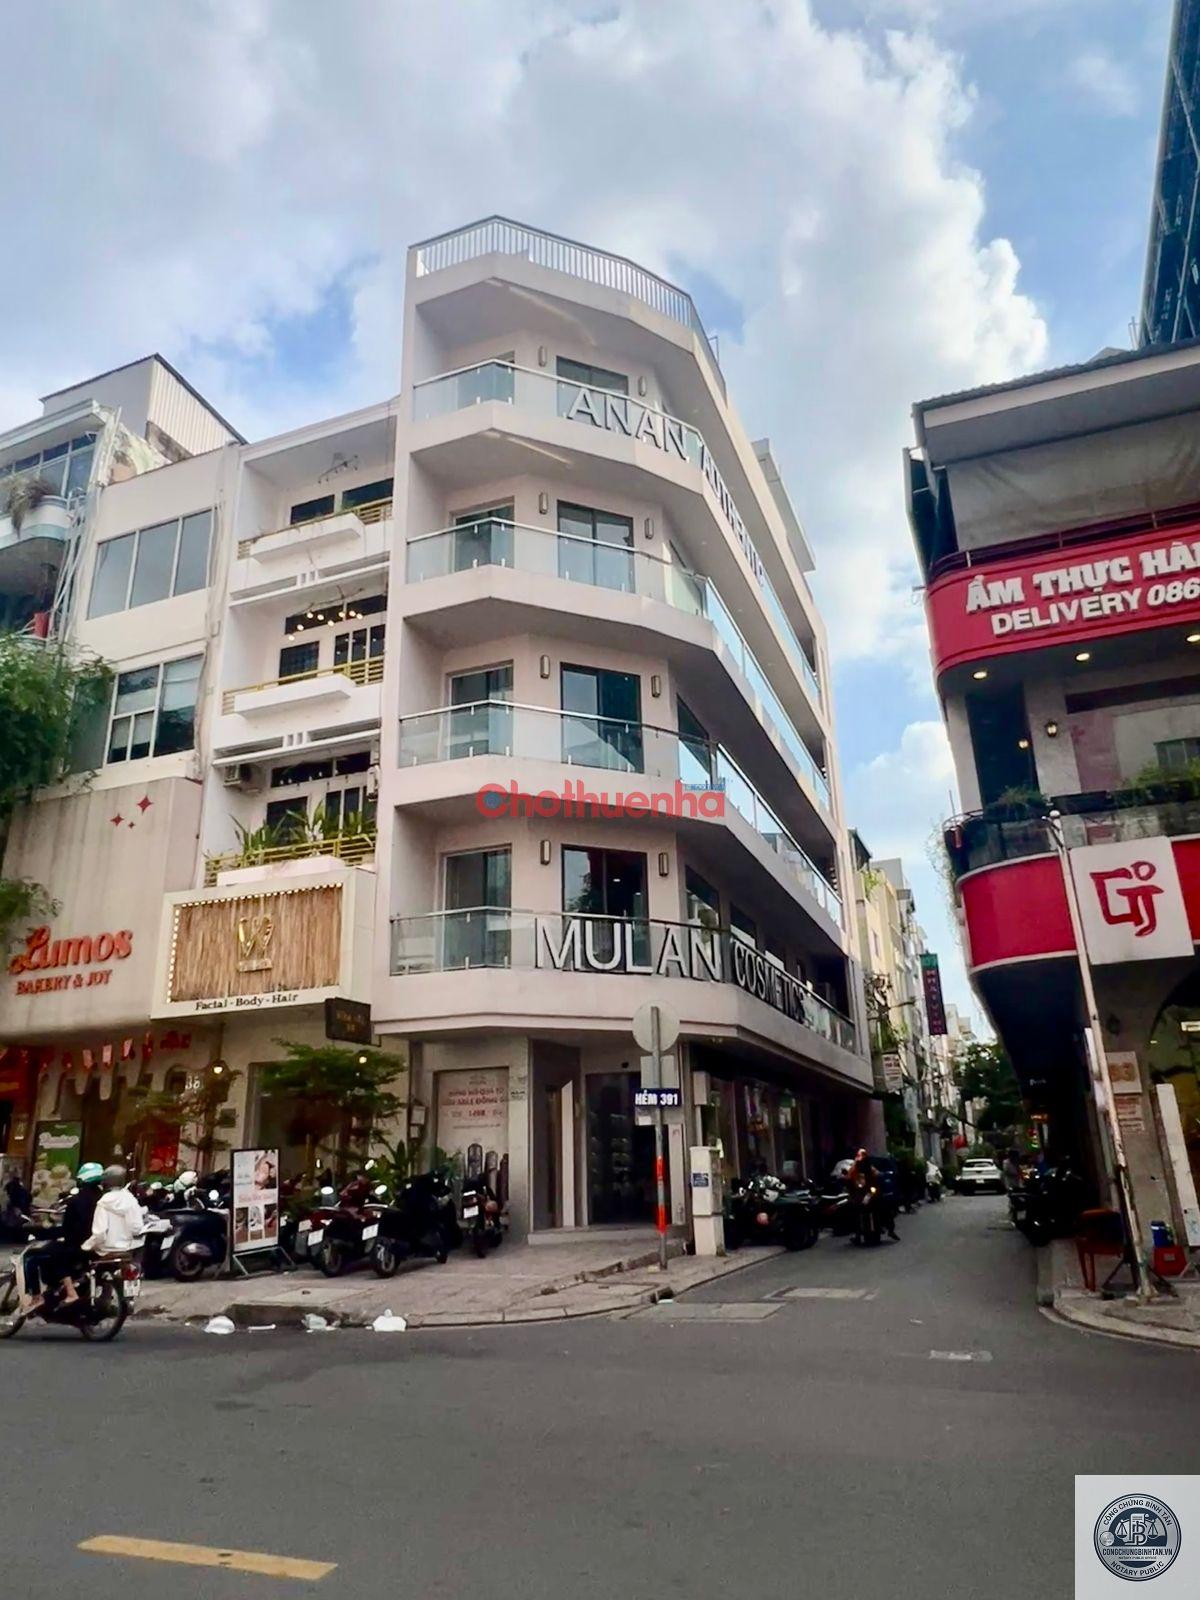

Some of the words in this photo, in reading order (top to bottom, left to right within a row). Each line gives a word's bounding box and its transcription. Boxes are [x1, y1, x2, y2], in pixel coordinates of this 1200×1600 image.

[565, 388, 688, 462] ANAN
[966, 574, 1025, 614] ẨM
[1032, 556, 1133, 598] THỰC
[991, 587, 1142, 635] DELIVERY
[1147, 577, 1200, 605] 086
[8, 925, 133, 975] Lumos
[534, 917, 722, 983] MULAN
[734, 942, 808, 1028] COSMETICS
[16, 975, 71, 995] BAKERY
[73, 974, 84, 989] &
[87, 969, 113, 987] JOY
[196, 999, 228, 1010] Facial
[236, 996, 263, 1007] Body
[272, 993, 298, 1003] Hair
[660, 1093, 678, 1106] 391
